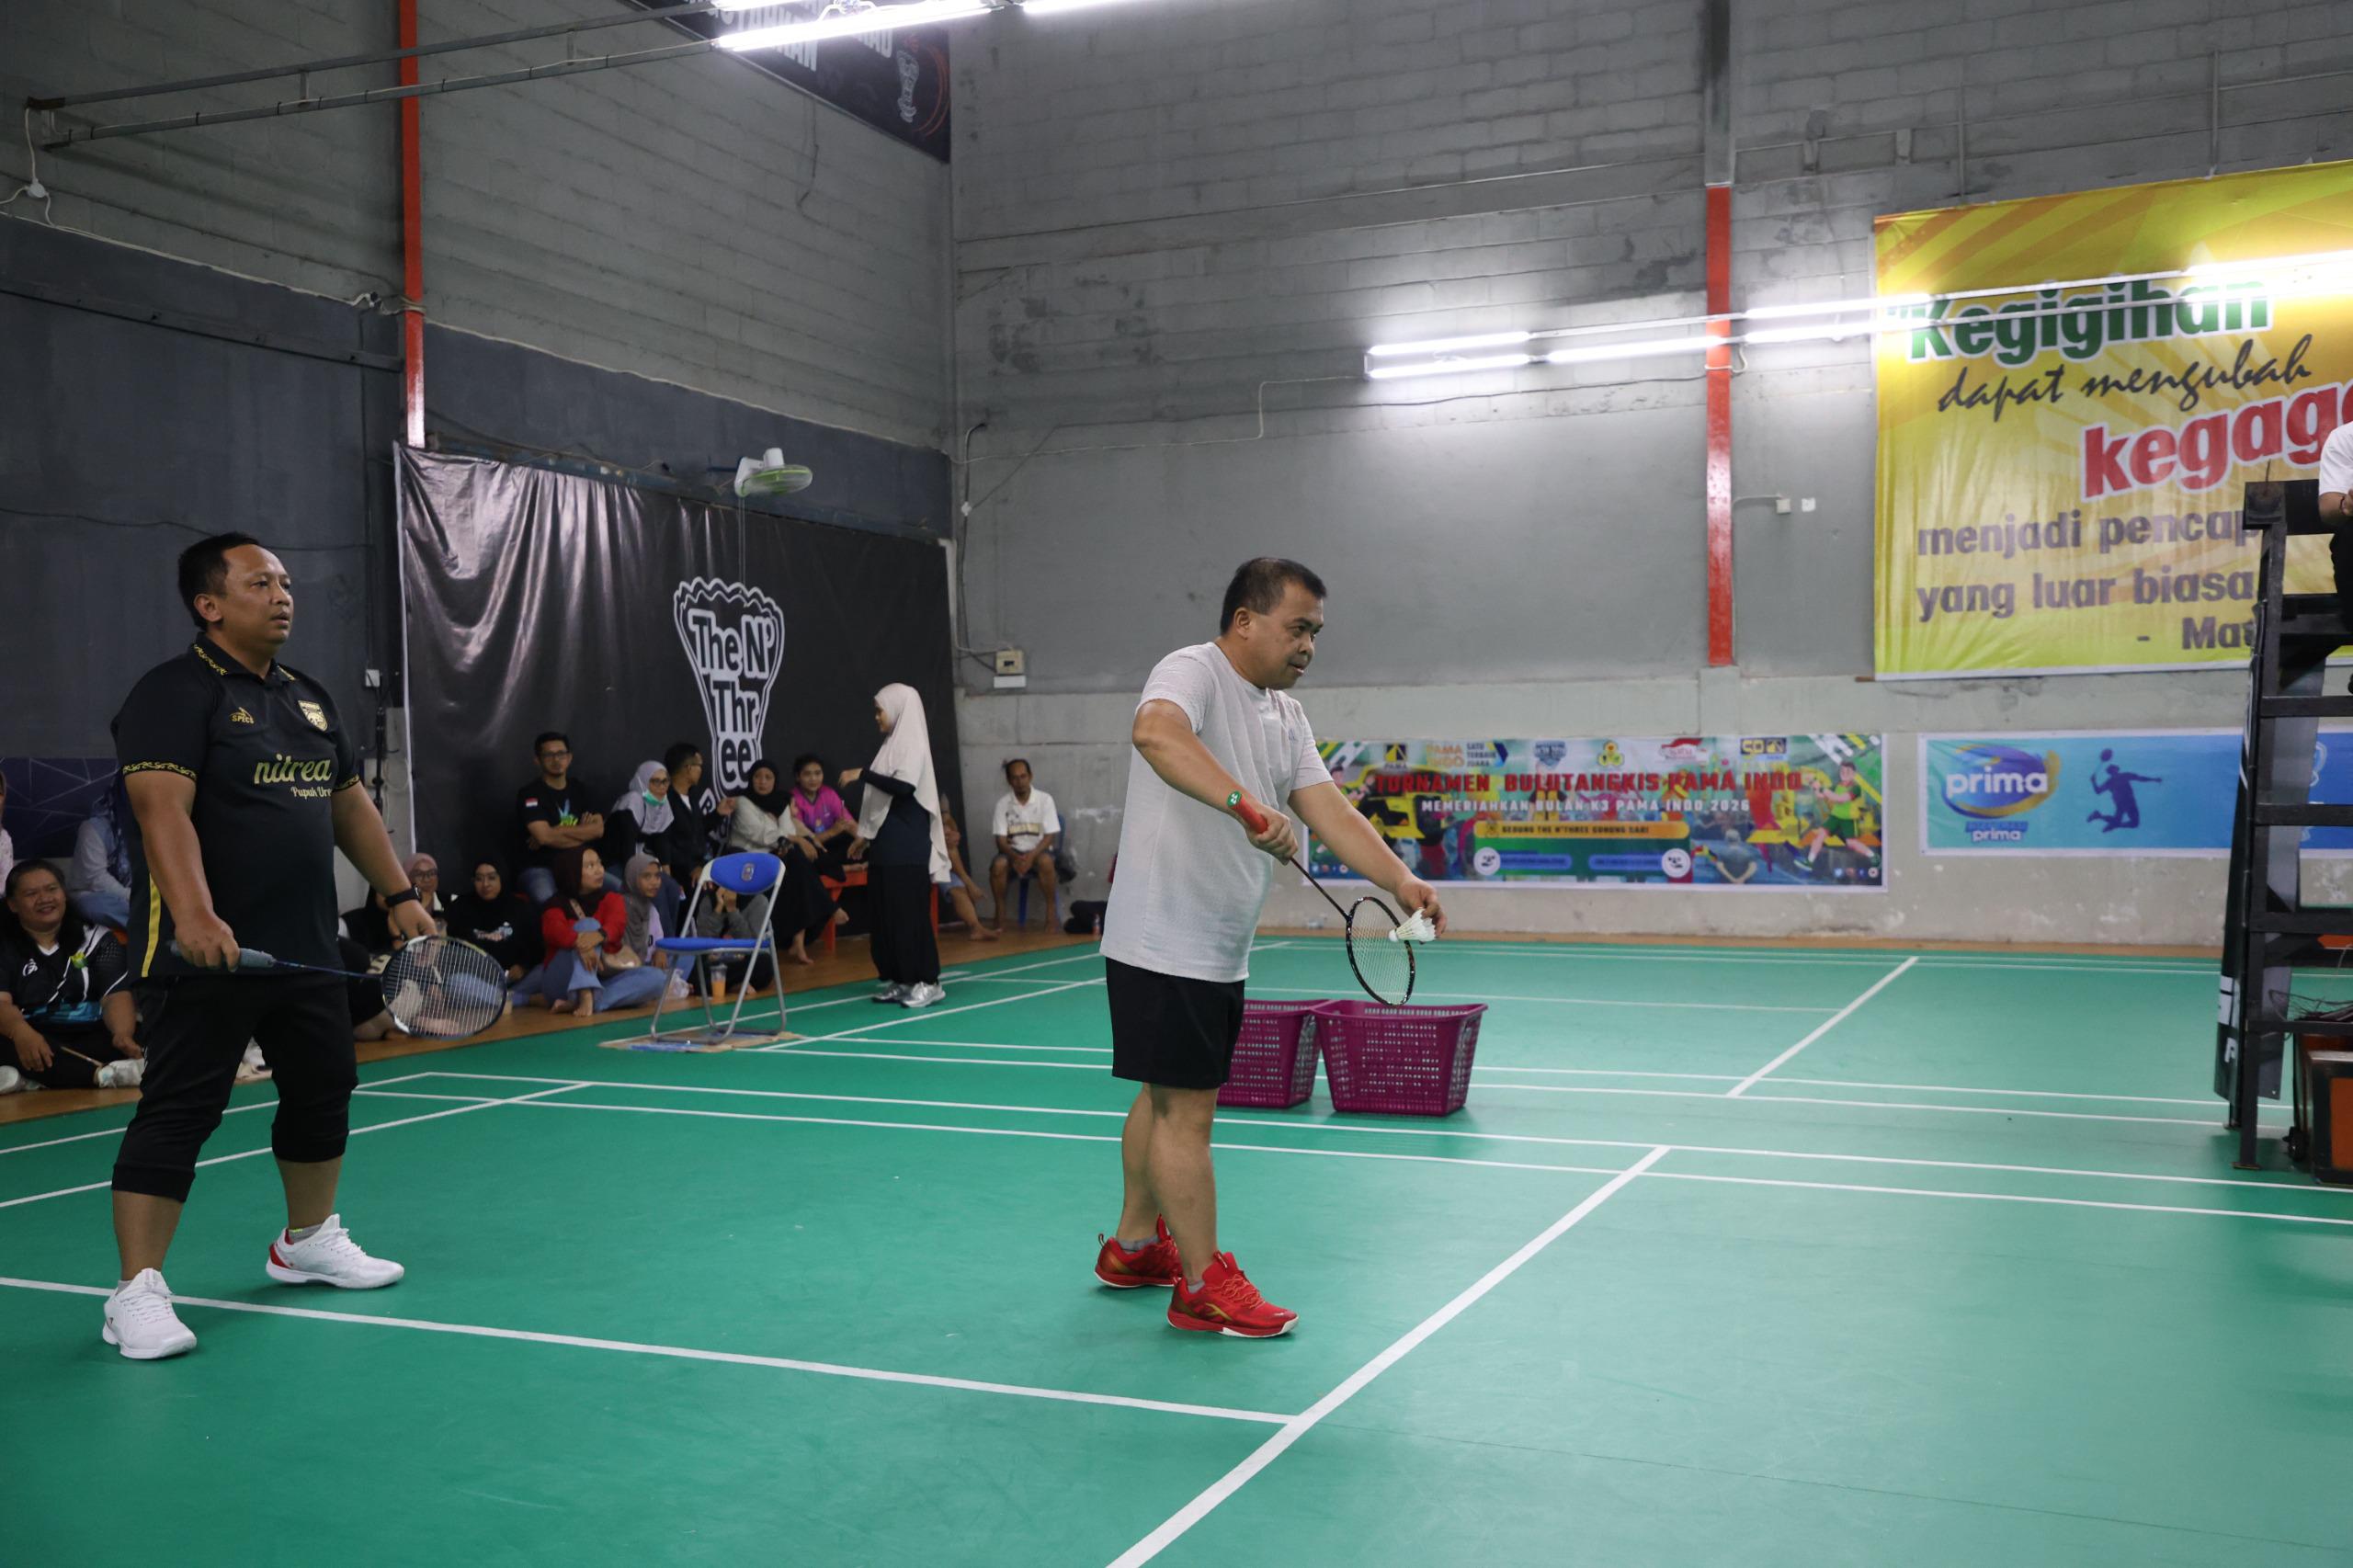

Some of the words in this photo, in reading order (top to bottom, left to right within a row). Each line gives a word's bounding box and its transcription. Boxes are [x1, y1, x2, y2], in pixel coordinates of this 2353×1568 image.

[1938, 365, 2065, 422] dapat
[2081, 333, 2313, 412] mengubah
[2084, 378, 2353, 499] kegag
[1917, 509, 2081, 560] menjadi
[1916, 582, 2015, 623] yang
[2032, 573, 2117, 609] luar
[2133, 564, 2255, 605] biasa
[690, 611, 741, 674] The
[232, 715, 255, 724] SPECS
[254, 754, 332, 784] nitrea
[1375, 773, 1491, 793] TURNAMEN
[1505, 771, 1660, 792] BULUTANGKIS
[1745, 771, 1802, 790] INDO
[1946, 766, 2048, 799] prima
[1422, 801, 1529, 812] MEMERIAHKAN
[1535, 800, 1583, 812] BULAN
[1616, 800, 1658, 812] PAMA
[1665, 800, 1703, 812] INDO
[1972, 828, 2021, 842] prima
